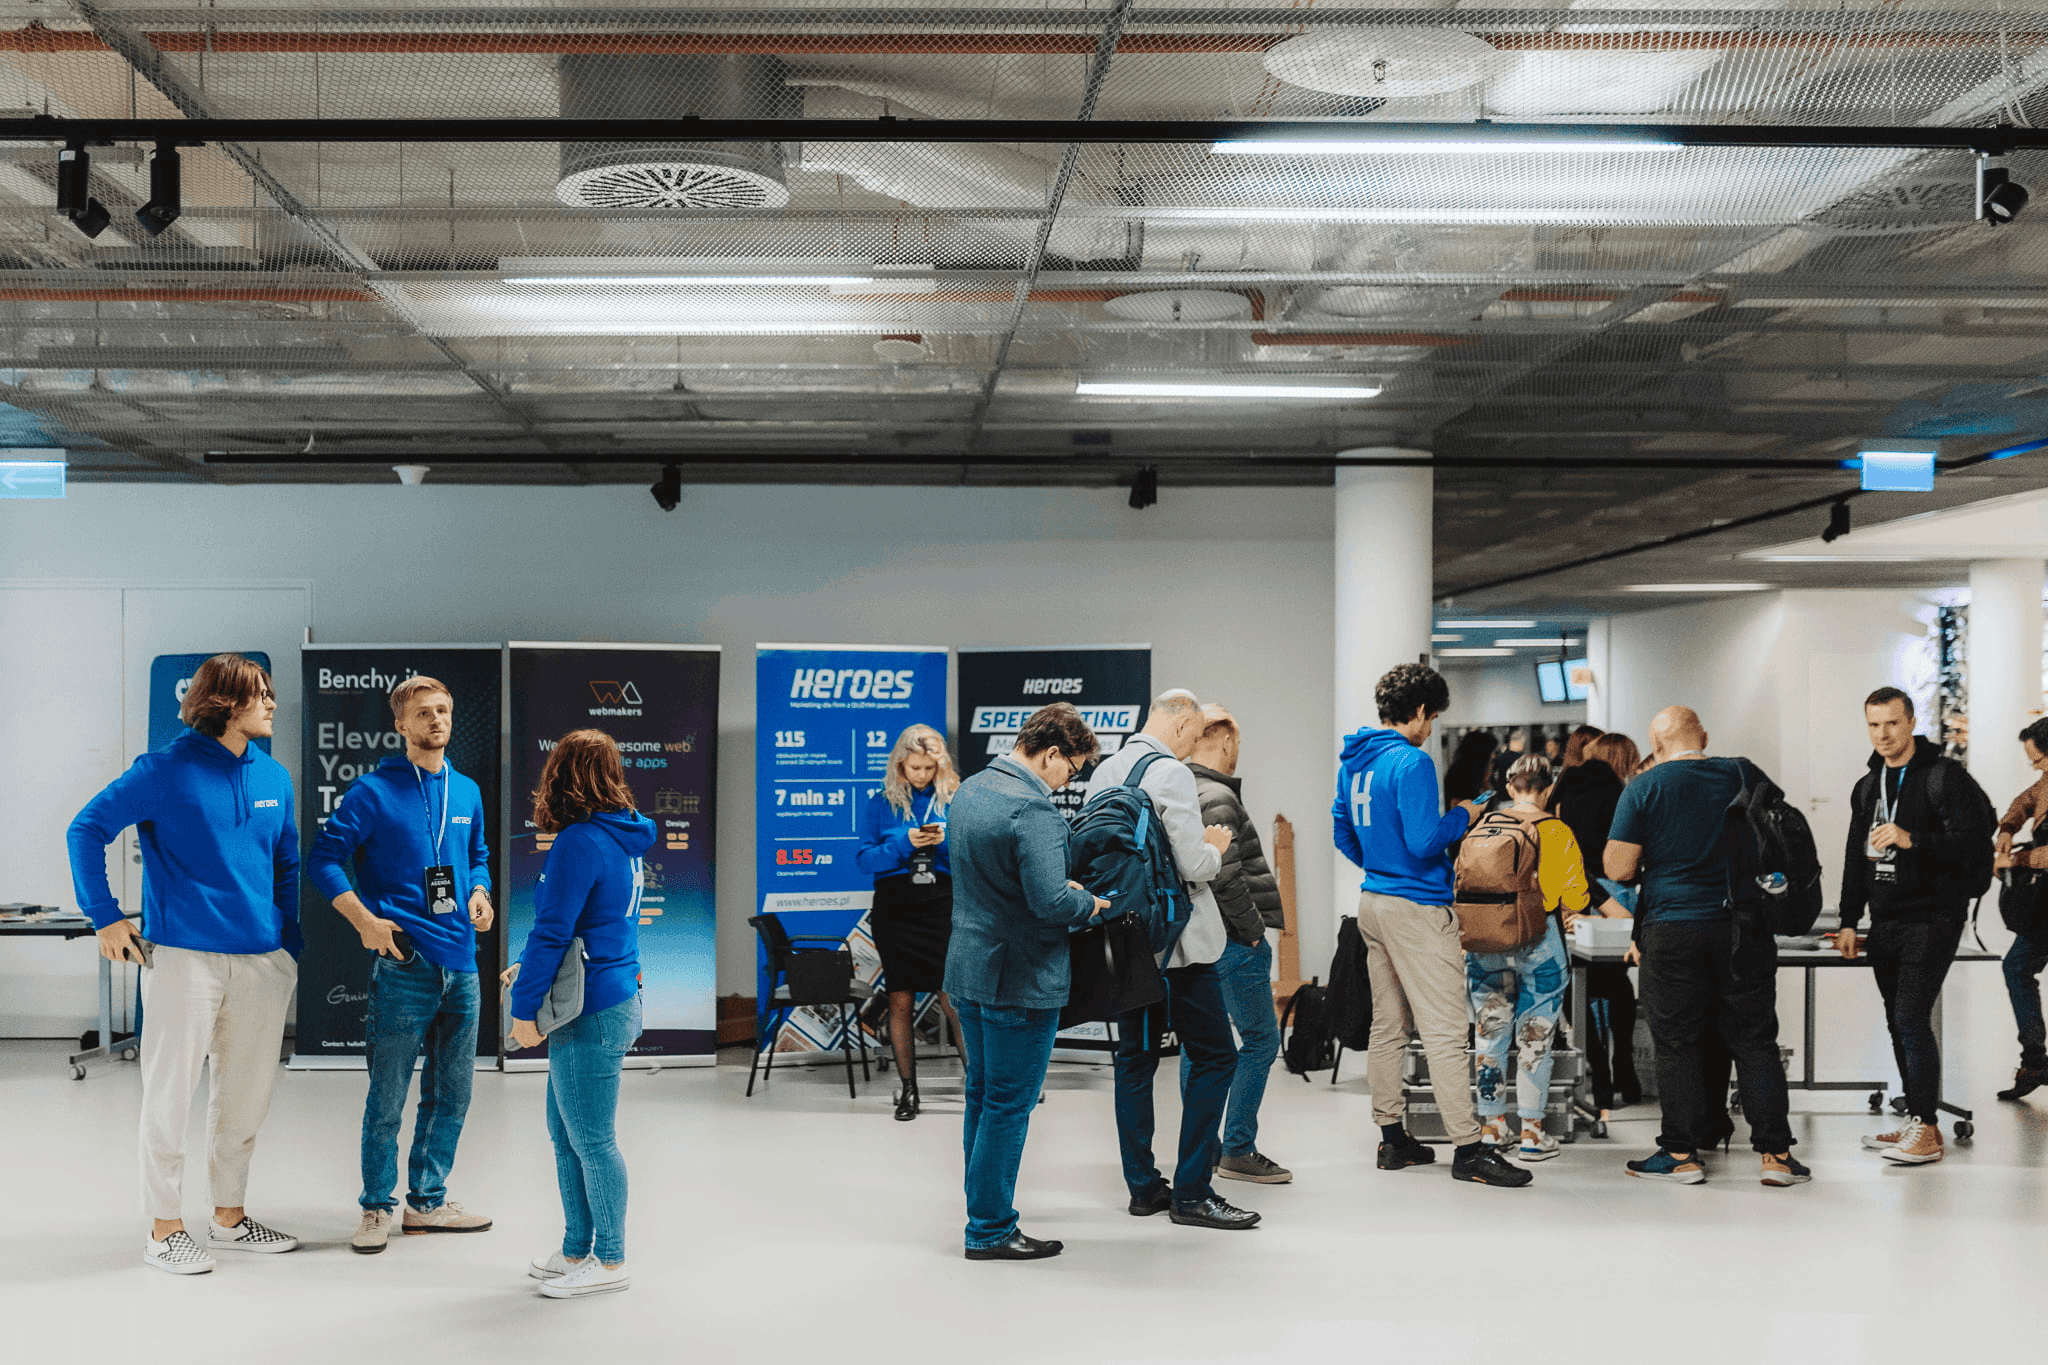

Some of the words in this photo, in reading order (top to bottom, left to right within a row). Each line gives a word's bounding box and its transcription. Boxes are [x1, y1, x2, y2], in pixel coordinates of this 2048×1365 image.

[319, 667, 397, 694] Benchy
[790, 668, 915, 700] Heroes
[1022, 677, 1084, 694] Heroes
[588, 707, 643, 717] webmakers
[318, 721, 401, 750] Eleva
[775, 730, 806, 748] 115
[866, 730, 888, 748] 12
[538, 739, 558, 751] We
[664, 740, 691, 752] web
[318, 754, 380, 782] You
[635, 758, 668, 769] apps
[775, 789, 787, 806] 7
[790, 789, 824, 806] mln
[827, 789, 845, 806] zł
[1068, 794, 1081, 804] to
[1351, 769, 1375, 827] H
[1060, 807, 1077, 819] ith
[665, 820, 690, 829] Design
[776, 849, 813, 865] 8.55
[815, 854, 833, 865] /10
[776, 896, 850, 908] www.heroes.pl
[326, 984, 370, 1005] Geniu
